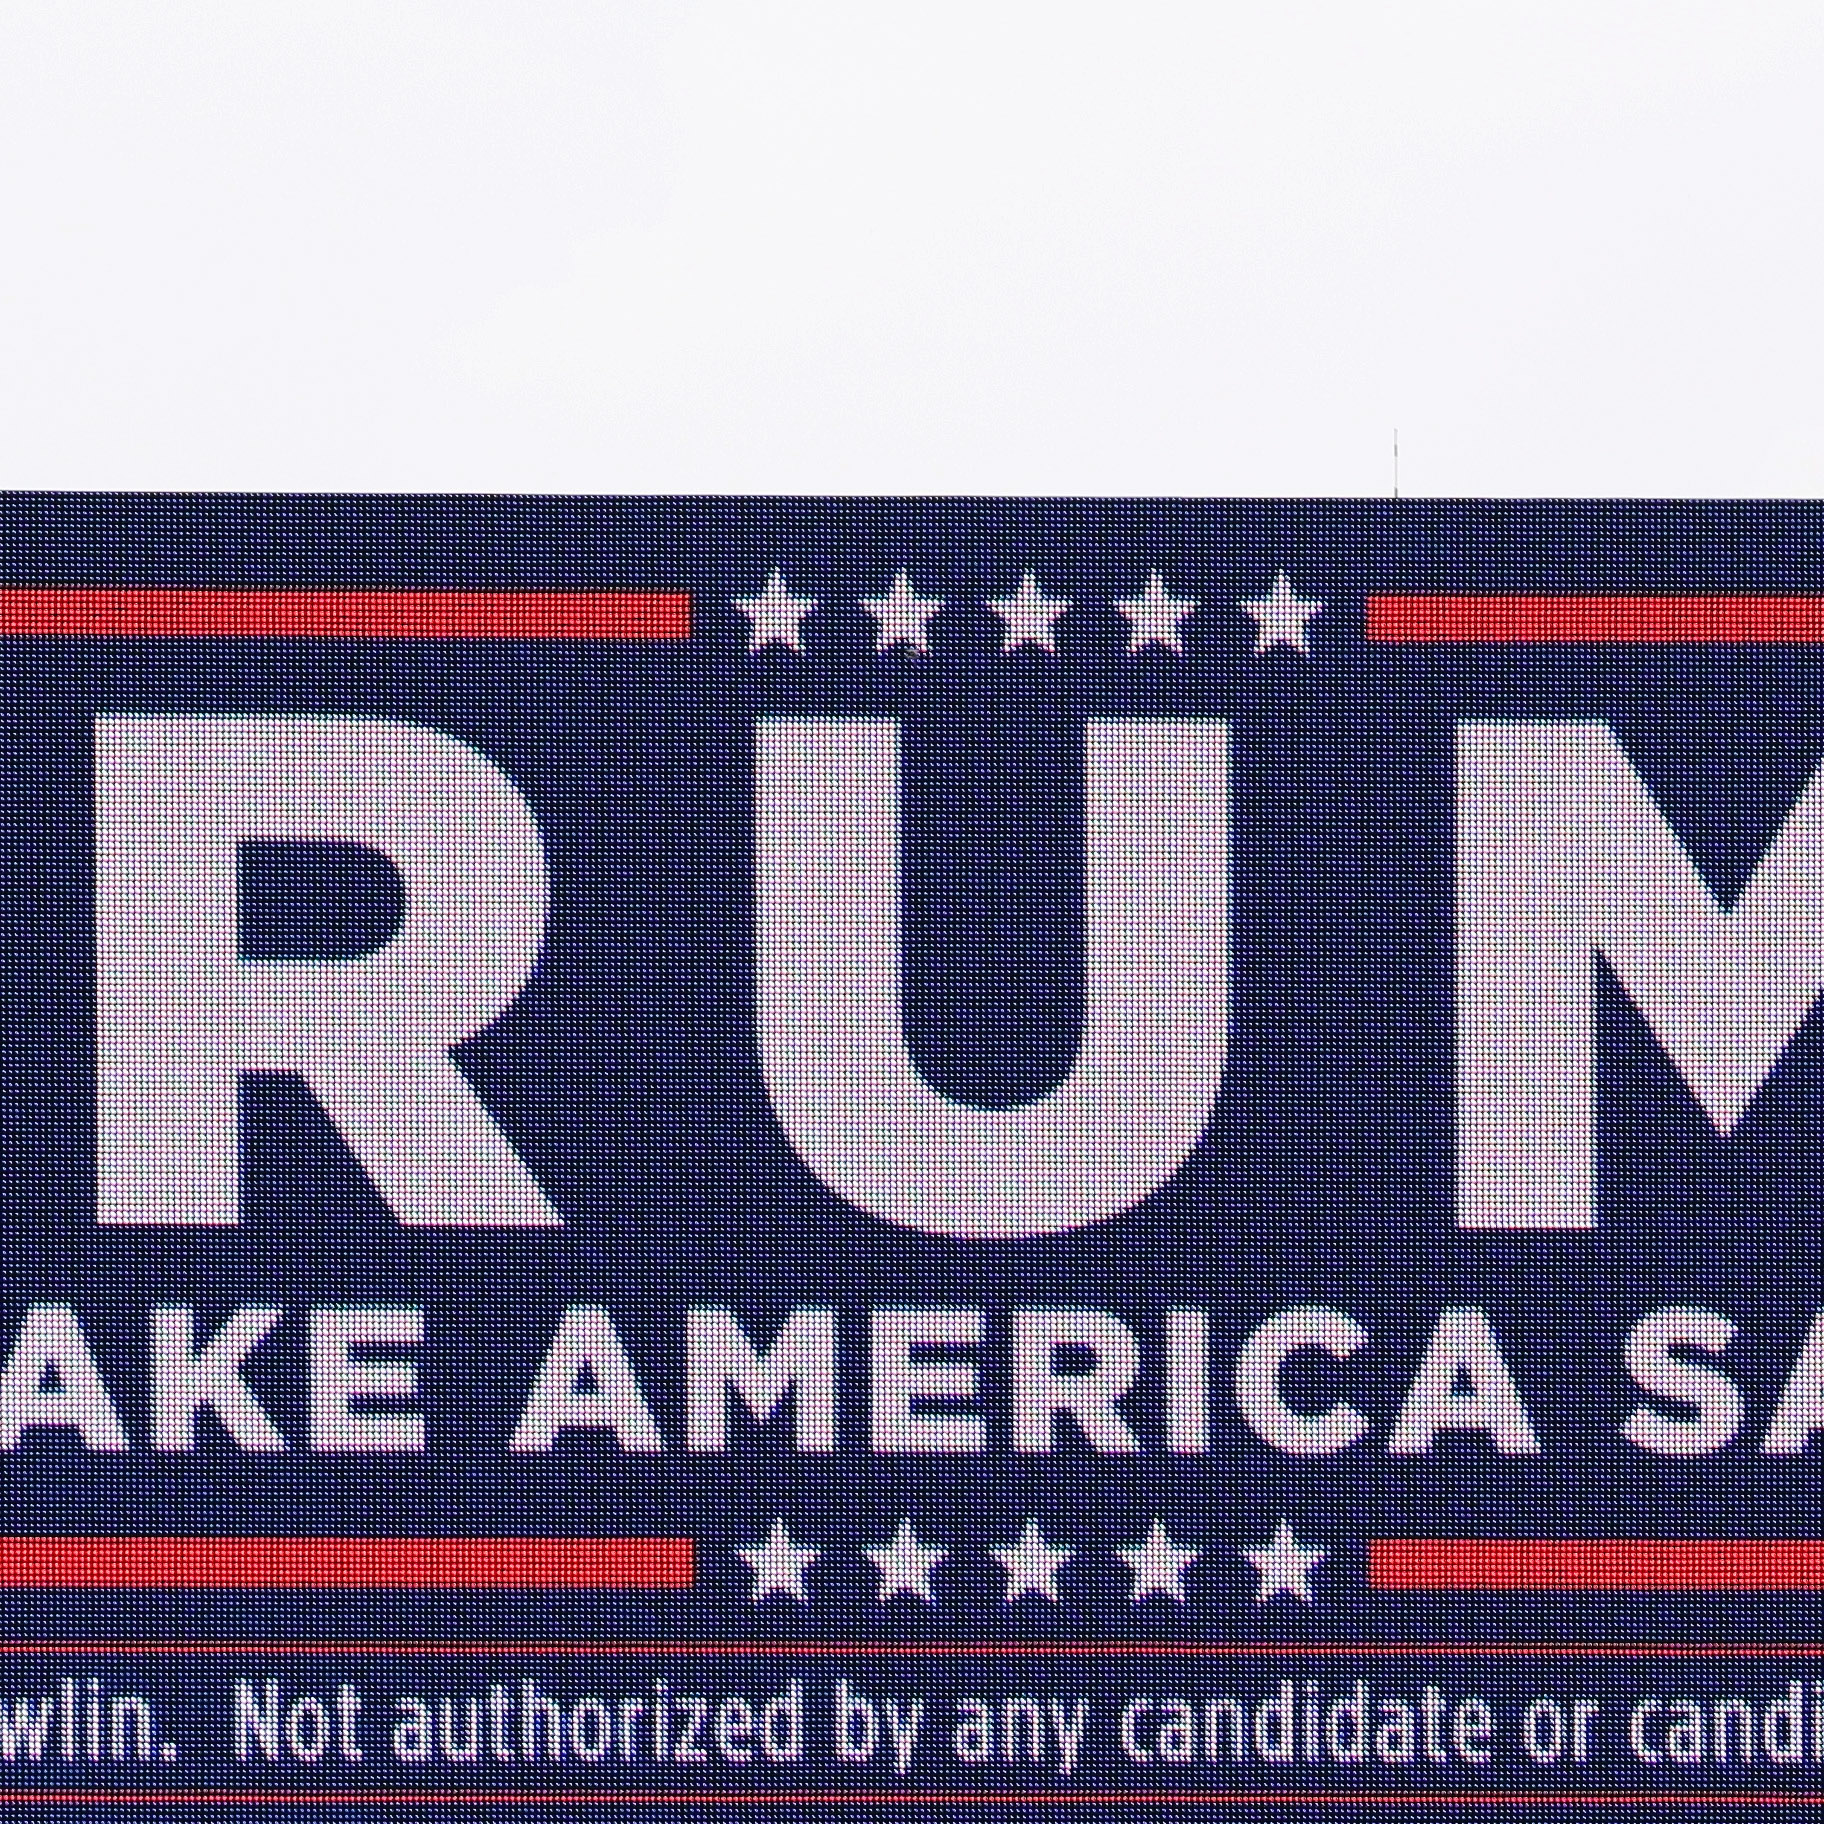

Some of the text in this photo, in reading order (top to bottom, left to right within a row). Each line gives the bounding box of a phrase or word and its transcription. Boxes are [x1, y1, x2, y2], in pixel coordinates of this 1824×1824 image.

[510, 1305, 1538, 1454] AMERICA
[235, 1681, 360, 1761] Not
[393, 1680, 802, 1761] authorized
[836, 1681, 922, 1772] by
[956, 1696, 1086, 1773] any
[1121, 1682, 1491, 1762] candidate
[1524, 1698, 1596, 1763] or
